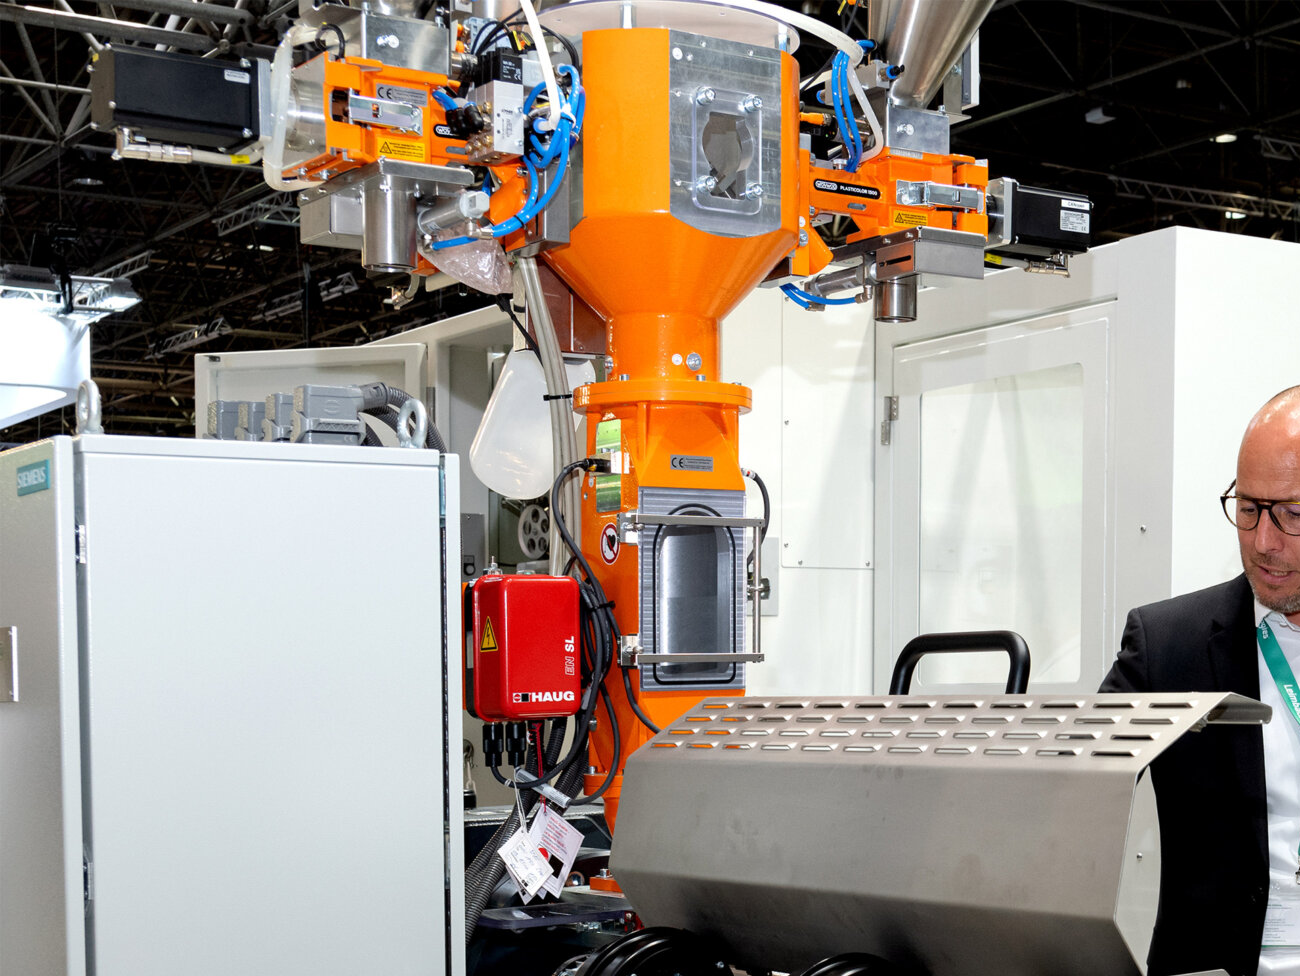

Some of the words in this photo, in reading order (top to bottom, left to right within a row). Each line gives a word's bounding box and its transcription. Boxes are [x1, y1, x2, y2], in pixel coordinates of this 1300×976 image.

[564, 636, 575, 653] SL
[565, 656, 575, 676] EN
[531, 691, 575, 703] HAUG
